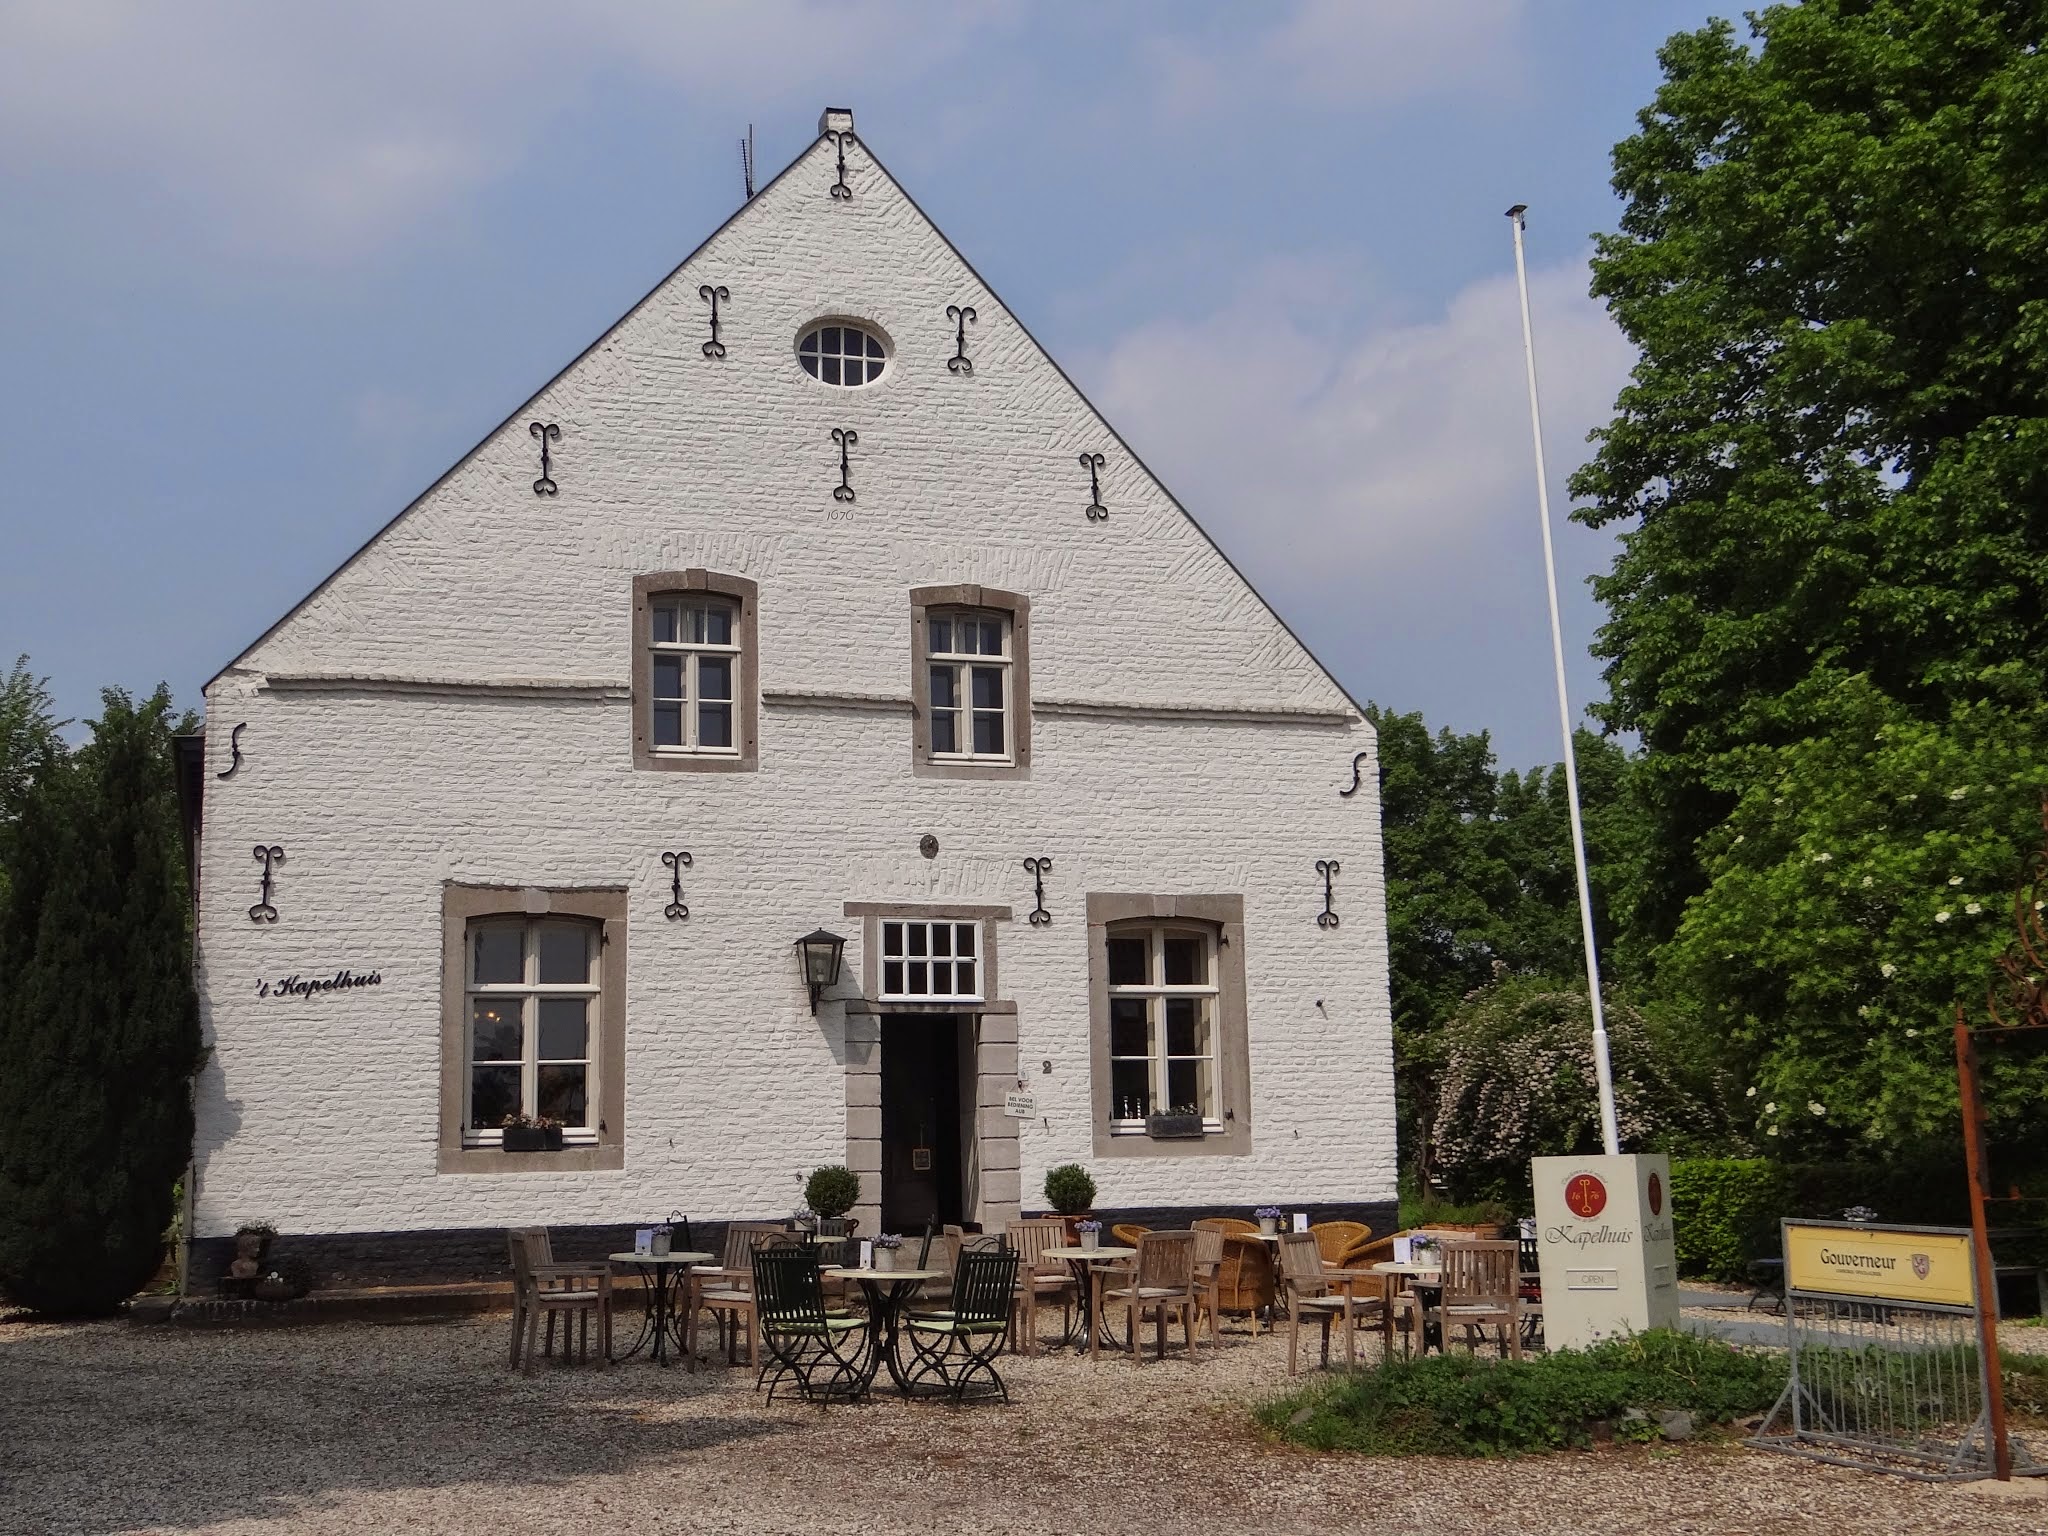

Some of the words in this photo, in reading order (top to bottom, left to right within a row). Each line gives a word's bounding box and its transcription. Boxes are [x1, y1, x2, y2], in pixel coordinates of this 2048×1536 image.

[827, 509, 854, 521] 1676
[273, 970, 382, 999] Kapelhuis
[1042, 1060, 1052, 1075] 2
[1007, 1101, 1034, 1110] BEDIENING
[1544, 1224, 1633, 1251] Kapelhuis
[1820, 1248, 1897, 1270] Gouverneur
[1581, 1275, 1604, 1284] OPEN
